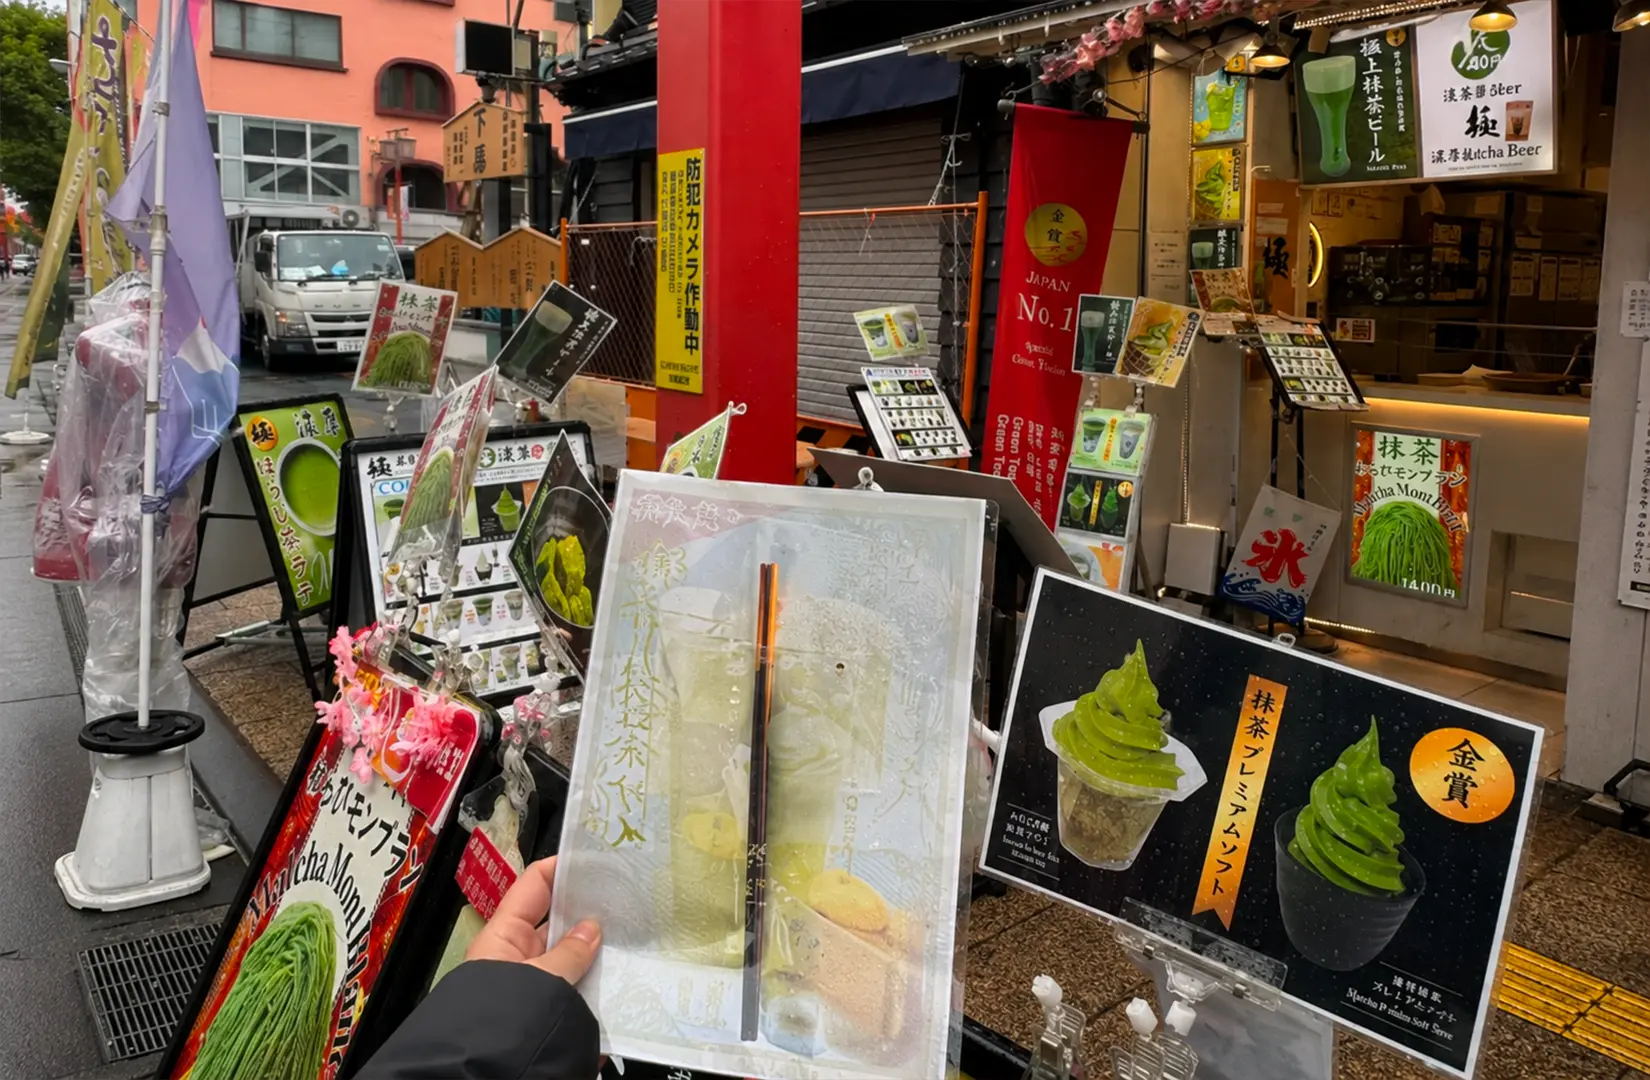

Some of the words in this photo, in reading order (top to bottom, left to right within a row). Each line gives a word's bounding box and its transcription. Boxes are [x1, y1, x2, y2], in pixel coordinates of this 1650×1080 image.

[473, 107, 487, 174] 下馬
[1507, 143, 1542, 158] Beer
[684, 157, 702, 355] 防犯カメラ作動中
[1047, 208, 1066, 243] 金賞
[1026, 270, 1072, 293] JAPAN
[1378, 435, 1439, 466] 抹茶
[1242, 527, 1310, 589] 氷
[1211, 688, 1276, 896] 抹茶プレミアムソフト
[1441, 737, 1486, 809] 金賞
